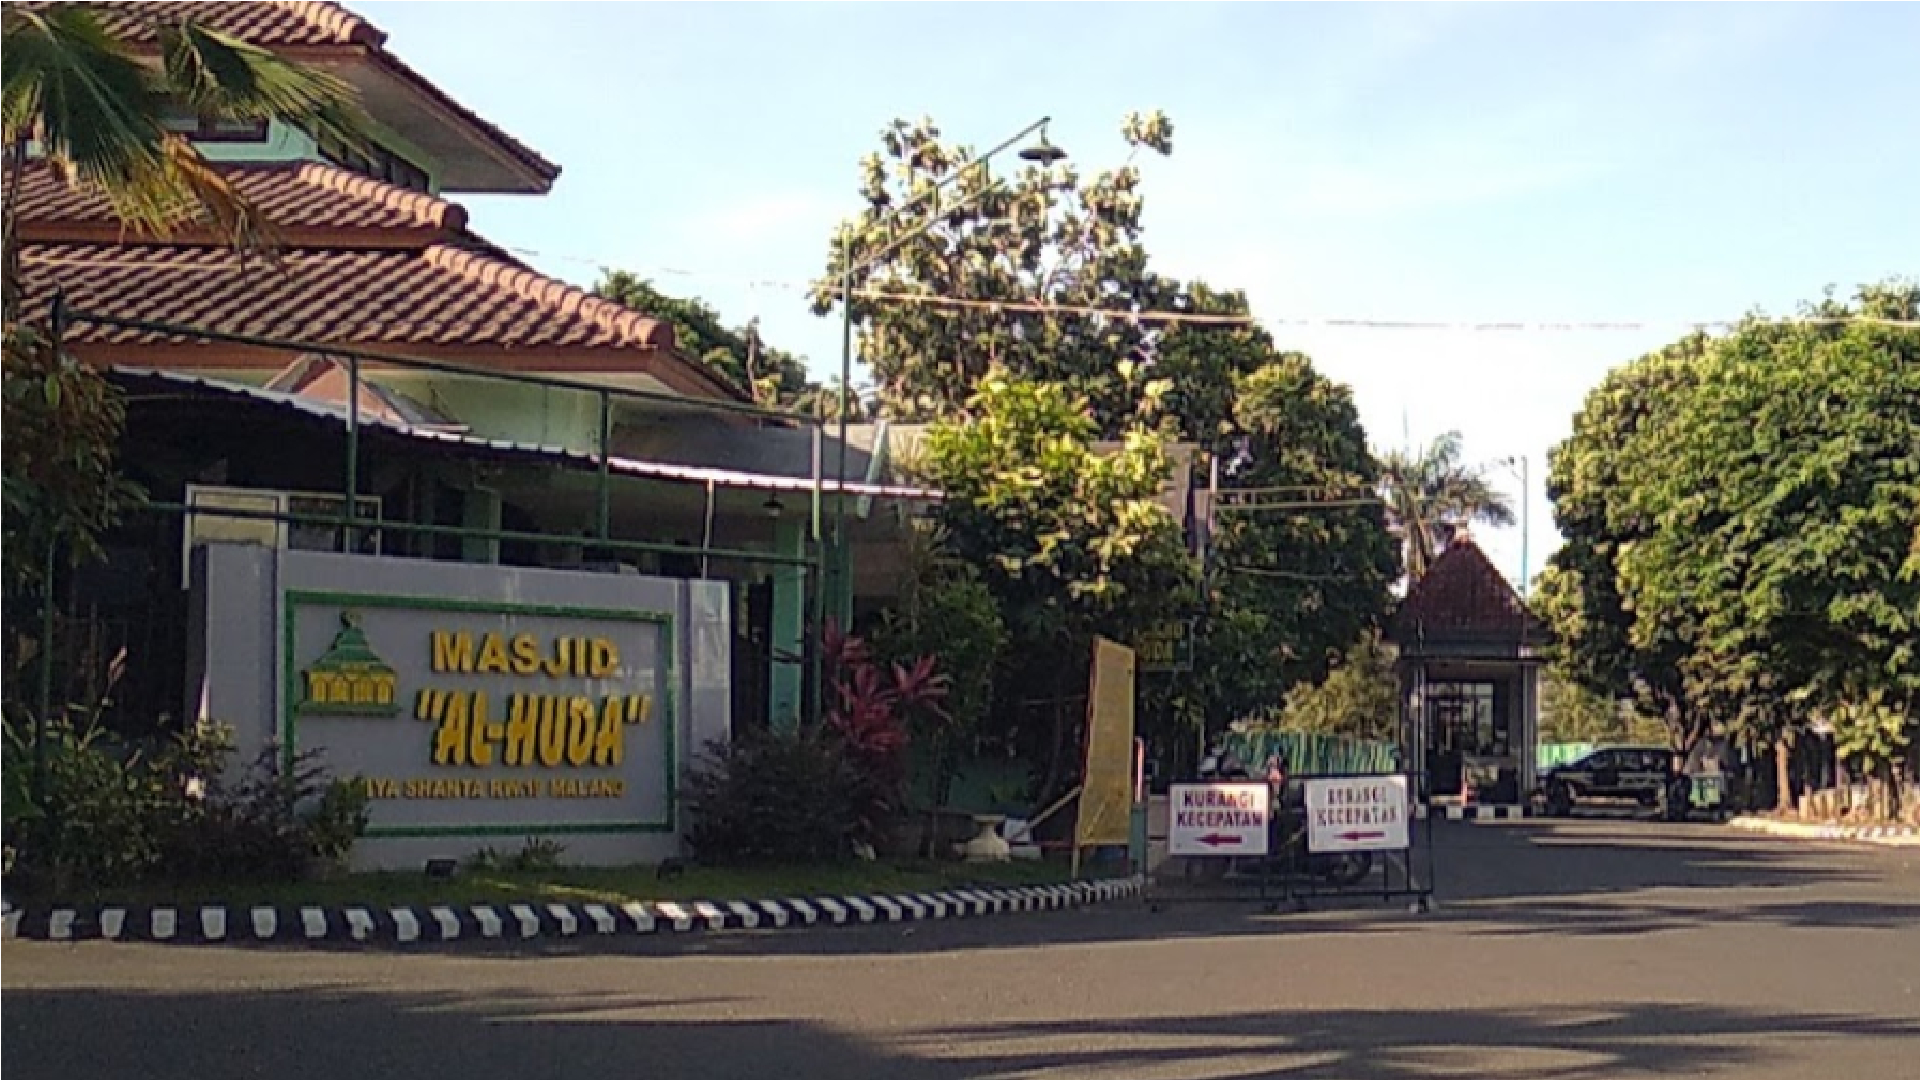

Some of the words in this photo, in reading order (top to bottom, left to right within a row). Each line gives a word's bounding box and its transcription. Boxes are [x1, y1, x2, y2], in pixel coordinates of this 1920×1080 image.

[430, 629, 620, 679] MASJID
[1183, 789, 1255, 809] KURANGI
[1176, 809, 1263, 829] KECEPATAN
